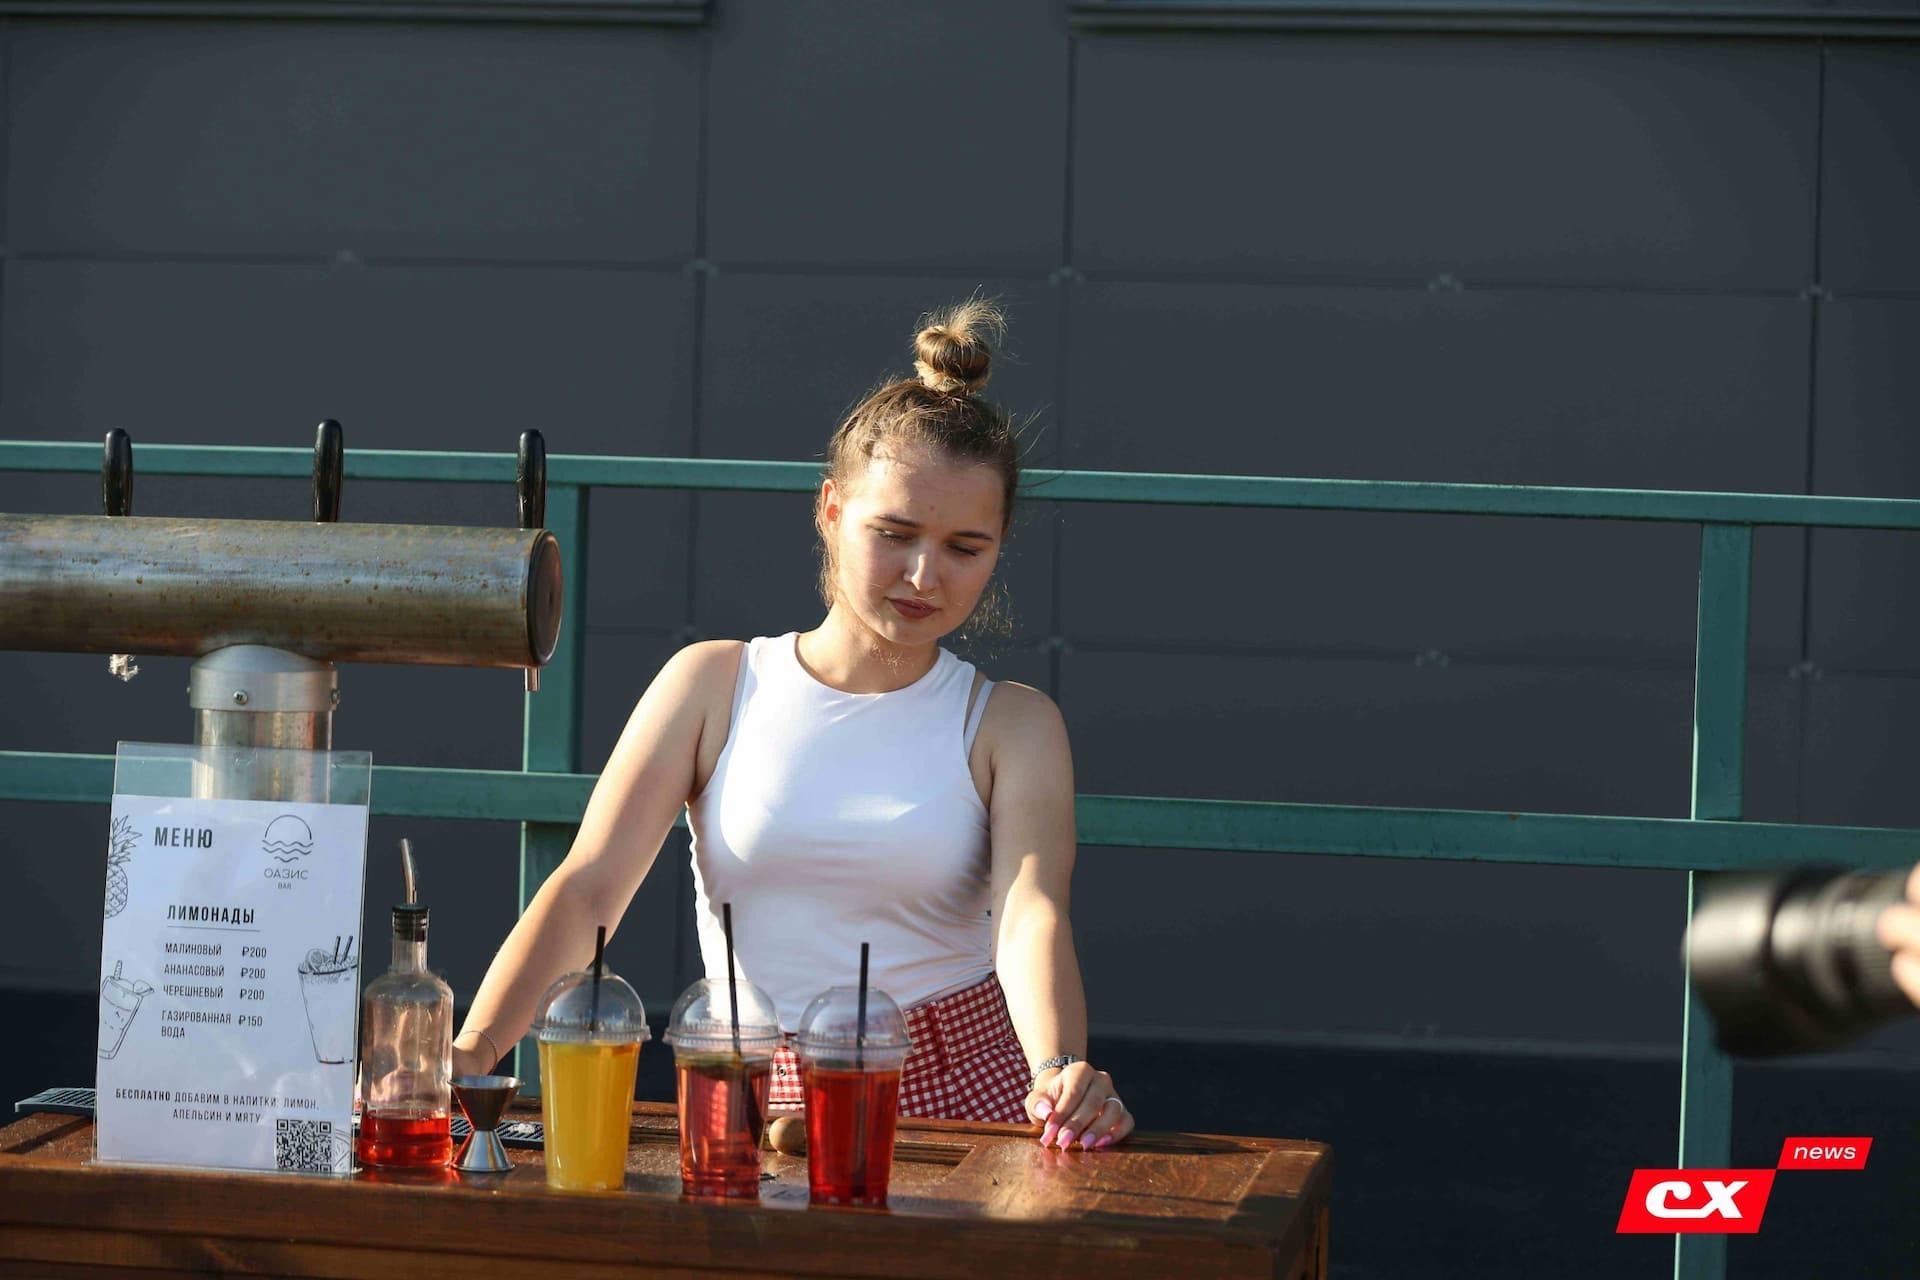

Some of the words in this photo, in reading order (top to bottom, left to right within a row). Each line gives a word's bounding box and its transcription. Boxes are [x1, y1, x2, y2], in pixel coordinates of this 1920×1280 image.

[154, 826, 213, 849] МЕНЮ
[263, 868, 309, 880] ОАЗИС
[167, 904, 254, 925] ЛИМОНАДЫ
[165, 942, 222, 956] МАЛИНОВЫЙ
[164, 964, 225, 977] АНАНАСОВЫЙ
[163, 984, 224, 999] ЧЕРЕШНЕВЫЙ
[161, 1010, 231, 1025] ГАЗИРОВАННАЯ
[161, 1025, 185, 1038] ВОДА
[115, 1088, 171, 1102] БЕСПЛАТНО
[174, 1091, 220, 1105] ДОБАВИМ
[223, 1094, 229, 1105] В
[173, 1108, 222, 1121] АПЕЛЬСИН
[225, 1112, 231, 1121] И
